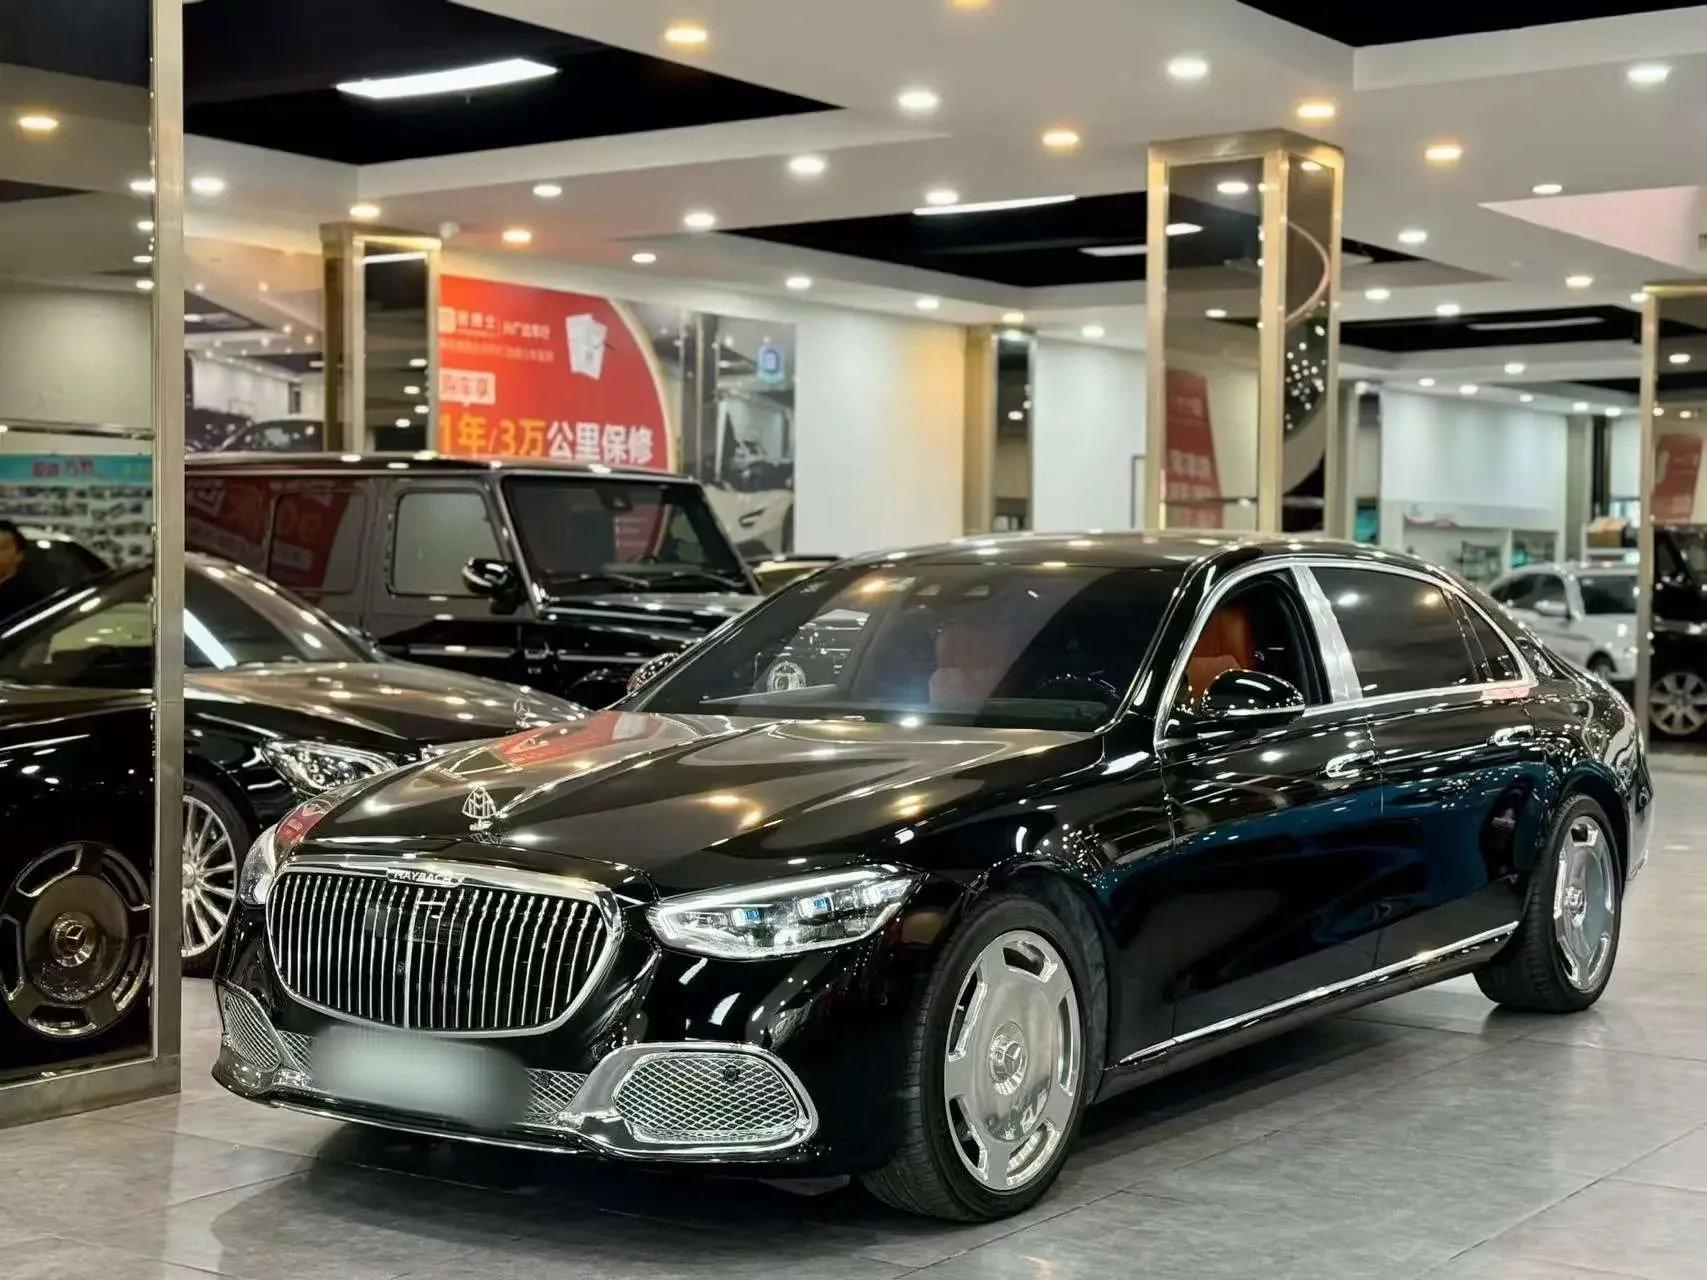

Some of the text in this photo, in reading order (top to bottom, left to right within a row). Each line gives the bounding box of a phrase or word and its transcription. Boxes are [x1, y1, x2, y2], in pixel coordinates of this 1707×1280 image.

[440, 412, 653, 465] 1年/3万公里保修
